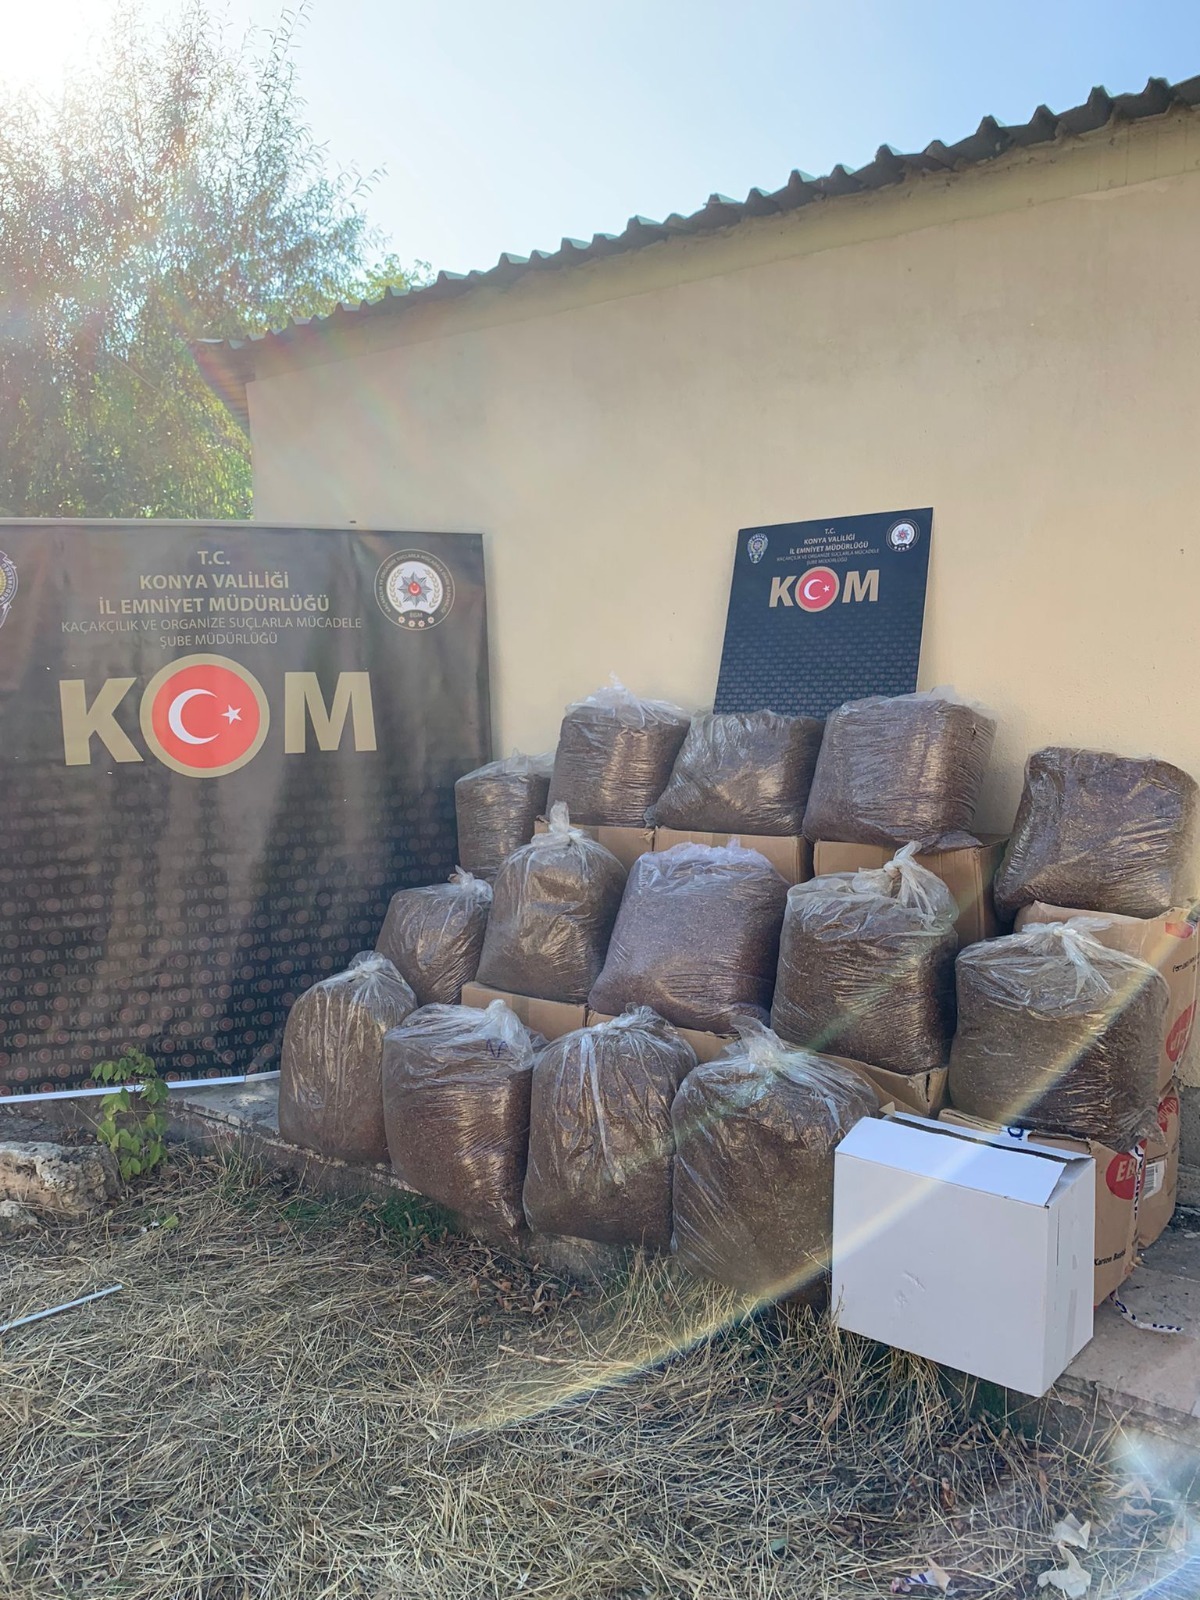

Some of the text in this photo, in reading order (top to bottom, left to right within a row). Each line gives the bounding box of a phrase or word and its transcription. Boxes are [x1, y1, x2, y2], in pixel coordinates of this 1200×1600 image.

[796, 545, 824, 554] EMNİYET
[824, 541, 869, 552] MÜDÜRLÜĞÜ
[803, 537, 827, 545] KONYA
[197, 551, 231, 565] T.C.
[140, 571, 289, 590] KONYA VALİLİĞİ
[768, 566, 880, 613] KOM
[99, 594, 330, 615] İL EMNİYET MÜDÜRLÜĞÜ
[61, 615, 362, 635] KAÇAKÇILIK VE ORGANİZE SUÇLARLA MÜCADELE
[160, 632, 278, 648] ŞUBE MÜDÜRLÜĞÜ
[59, 653, 378, 778] KOM
